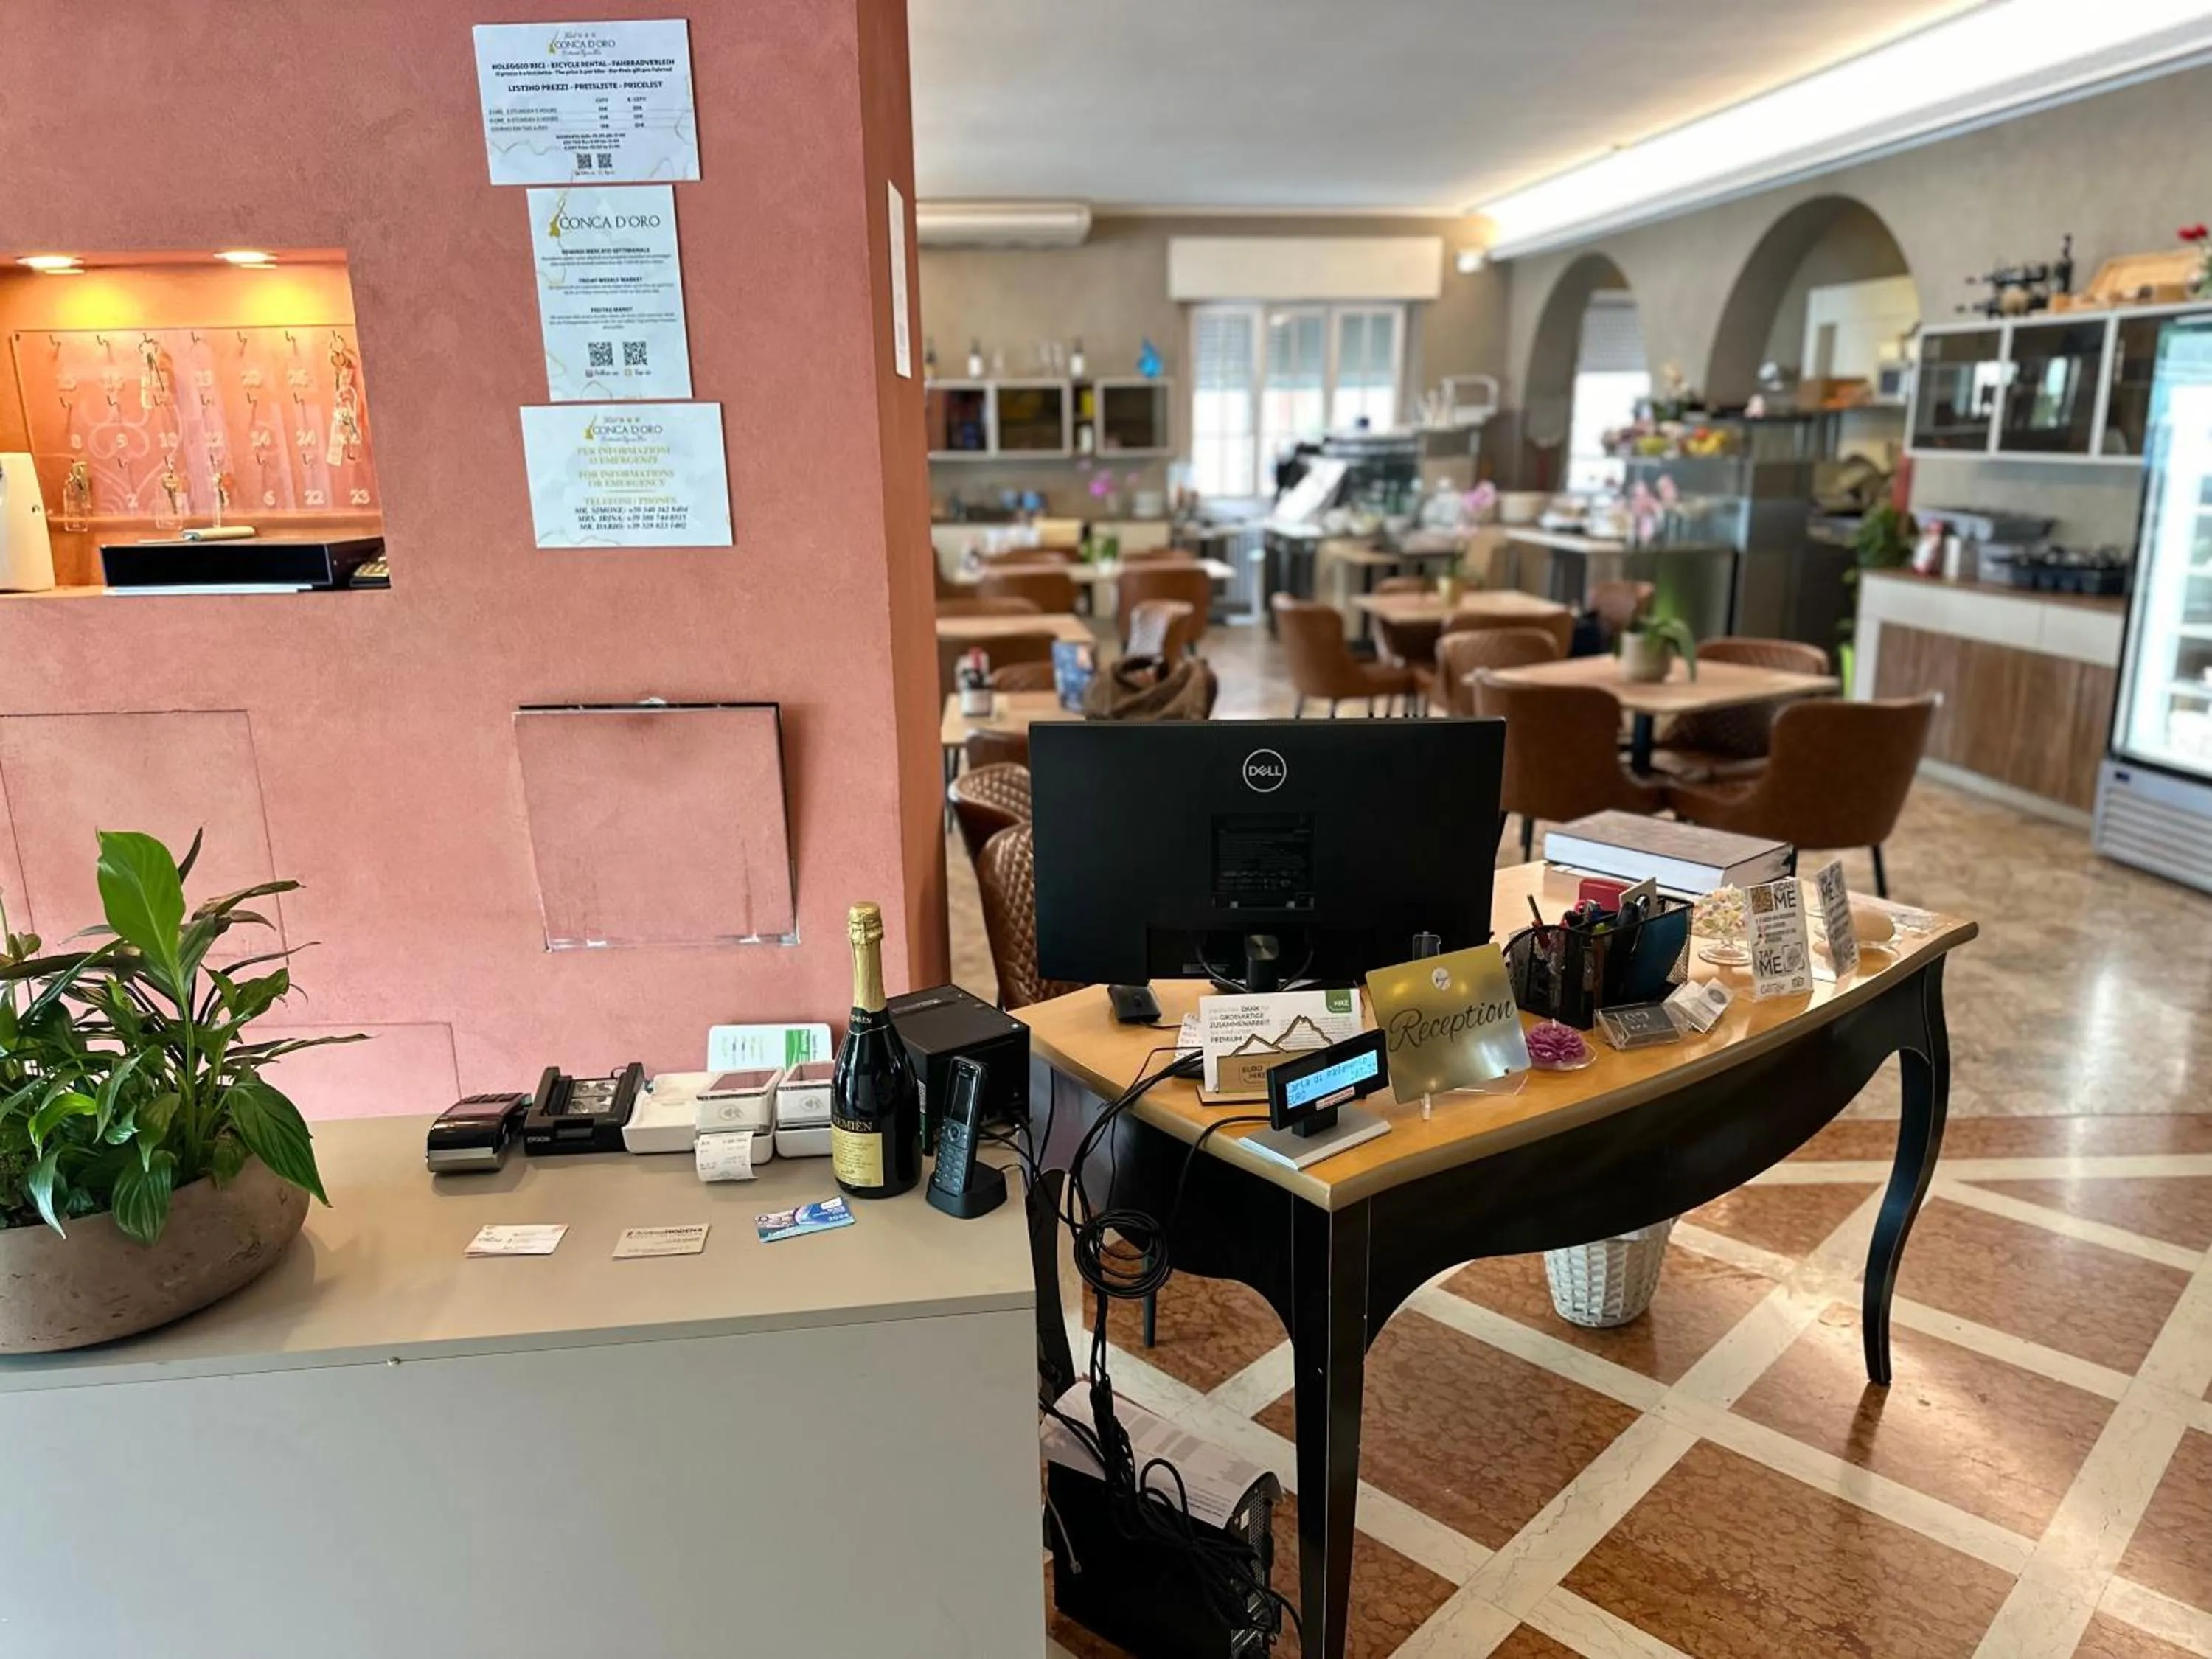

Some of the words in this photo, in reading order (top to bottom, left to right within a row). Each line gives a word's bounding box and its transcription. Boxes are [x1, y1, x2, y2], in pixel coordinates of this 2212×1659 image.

[554, 40, 585, 49] CONCA
[492, 62, 528, 70] NOLEGGIO
[611, 58, 675, 66] FAHRRADVERLEIH
[508, 84, 540, 92] LISTINO
[574, 82, 617, 90] PREISLISTE
[623, 80, 663, 88] PRICELIST
[560, 215, 611, 230] CONCA
[616, 215, 660, 229] D'ORO
[592, 425, 628, 435] CONCA
[577, 446, 596, 456] PER
[597, 445, 670, 455] INFORMAZIONI
[579, 470, 598, 479] FOR
[600, 469, 674, 479] INFORMATIONS
[588, 479, 603, 487] OR
[605, 479, 665, 487] EMERGENCY
[305, 490, 325, 505] 22
[349, 488, 370, 505] 23
[1248, 765, 1282, 776] DELL
[1774, 890, 1797, 911] ME
[1758, 949, 1774, 959] TAP
[1759, 956, 1782, 977] ME
[1241, 1004, 1260, 1012] DANK
[1209, 1019, 1270, 1029] ZUSAMMENARBEIT
[1388, 999, 1512, 1052] Reception
[1209, 1034, 1243, 1044] PREMIUM
